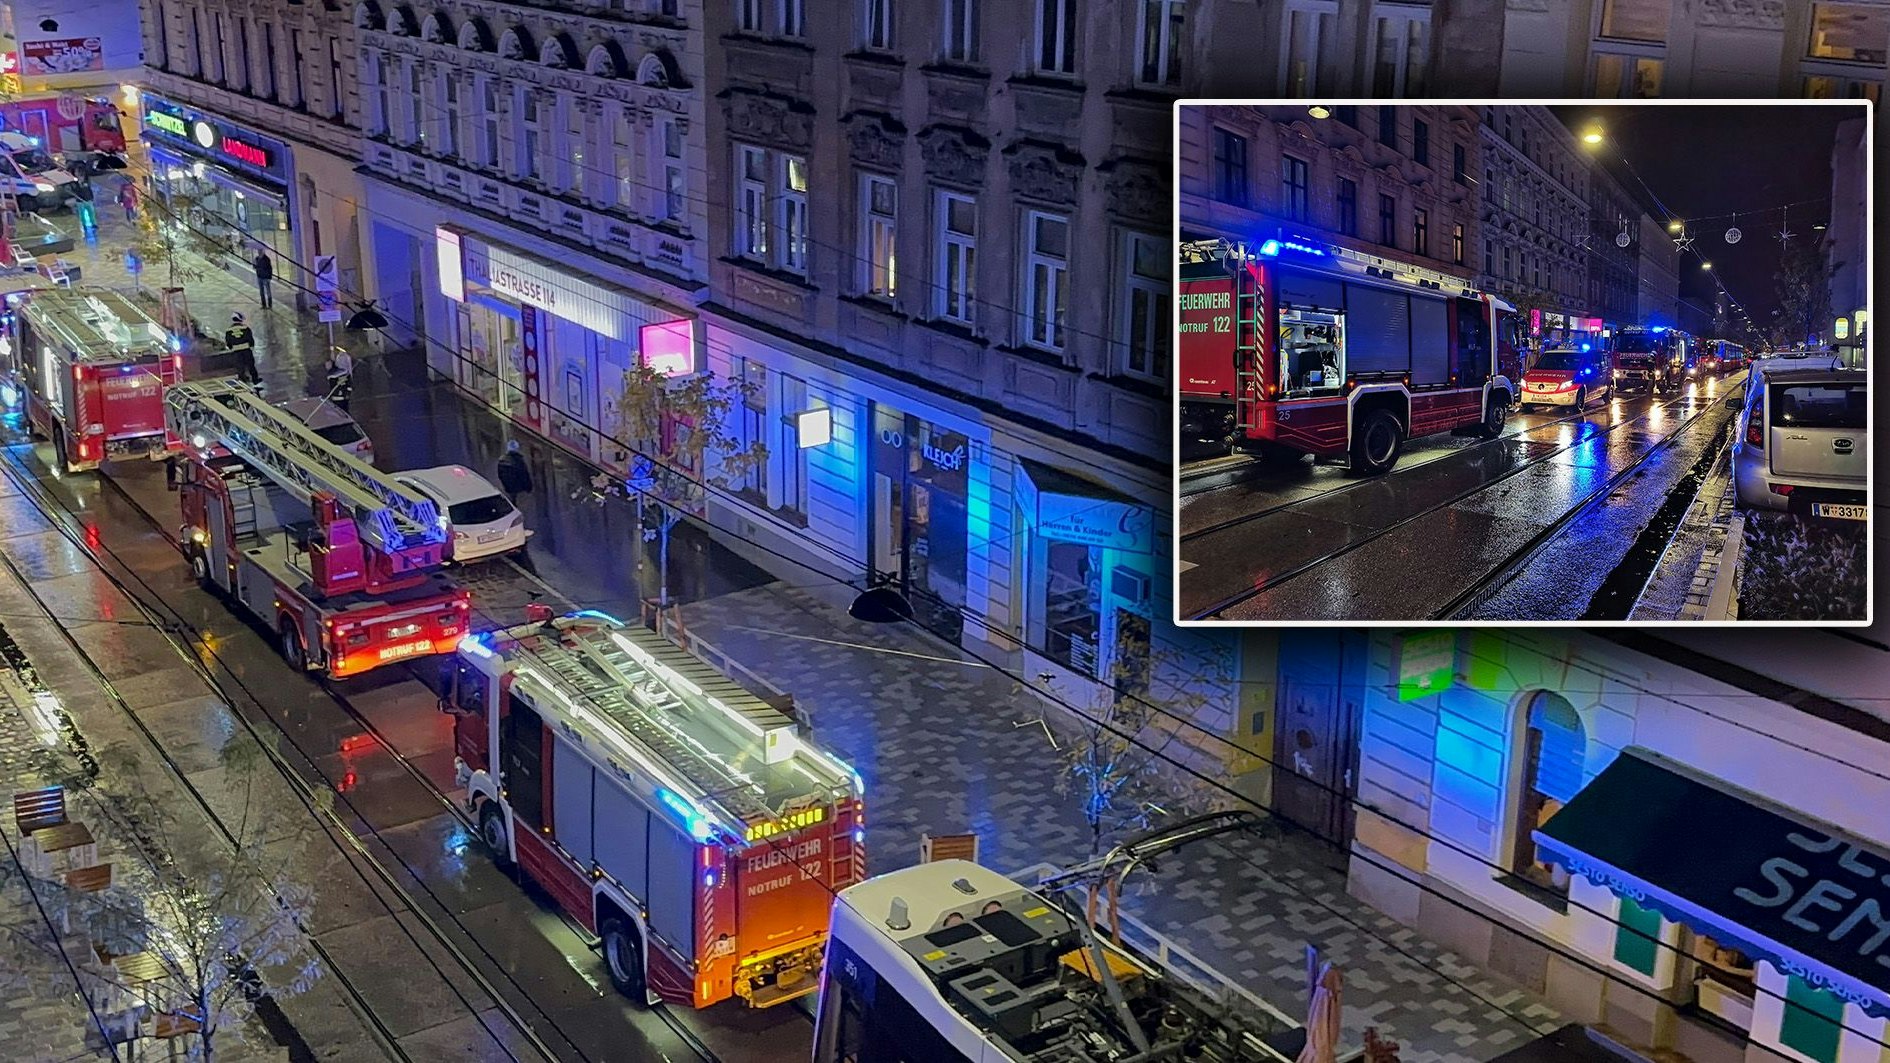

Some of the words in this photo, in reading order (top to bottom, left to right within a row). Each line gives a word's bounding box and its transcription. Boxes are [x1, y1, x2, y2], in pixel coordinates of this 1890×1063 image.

[1212, 316, 1231, 333] 122
[141, 385, 156, 397] 122
[1278, 410, 1291, 421] 25
[1821, 505, 1830, 516] W
[1042, 521, 1073, 533] Herren
[1083, 526, 1113, 538] Kinder
[380, 642, 415, 659] NOTRUF
[415, 640, 430, 652] 122
[747, 838, 821, 873] FEUERWEHR
[748, 874, 793, 896] NOTRUF
[799, 861, 821, 881] 122
[1568, 859, 1605, 883] SESTO
[1780, 956, 1823, 985] SESTO
